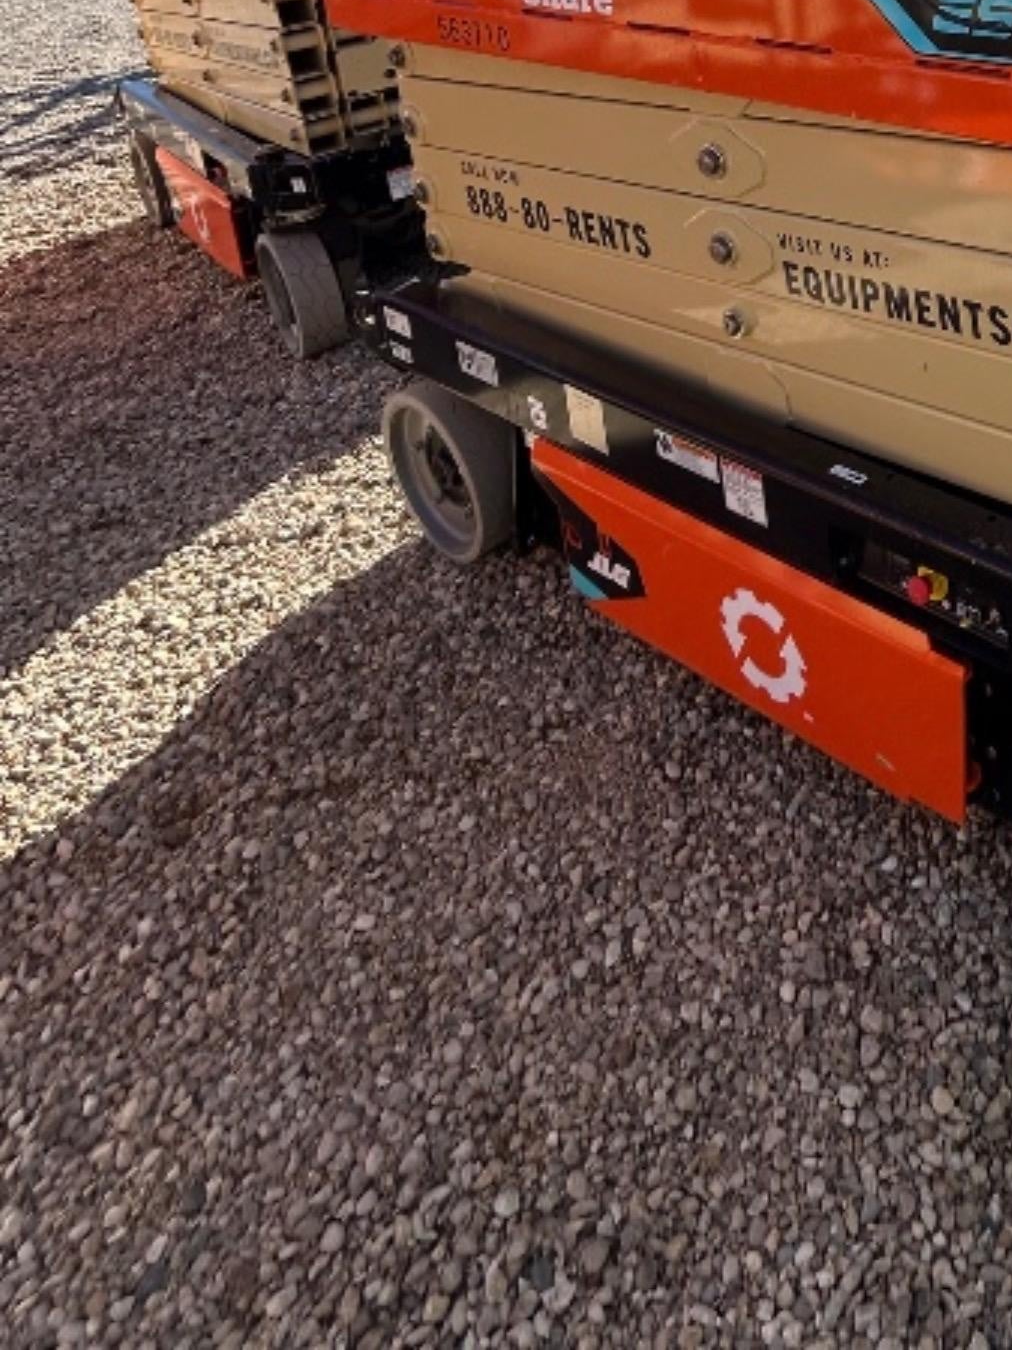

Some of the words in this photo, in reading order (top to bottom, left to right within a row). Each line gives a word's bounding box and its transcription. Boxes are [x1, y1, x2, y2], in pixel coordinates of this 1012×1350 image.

[465, 185, 652, 259] 888-80-RENTS
[776, 233, 822, 255] VISIT
[829, 241, 853, 262] US
